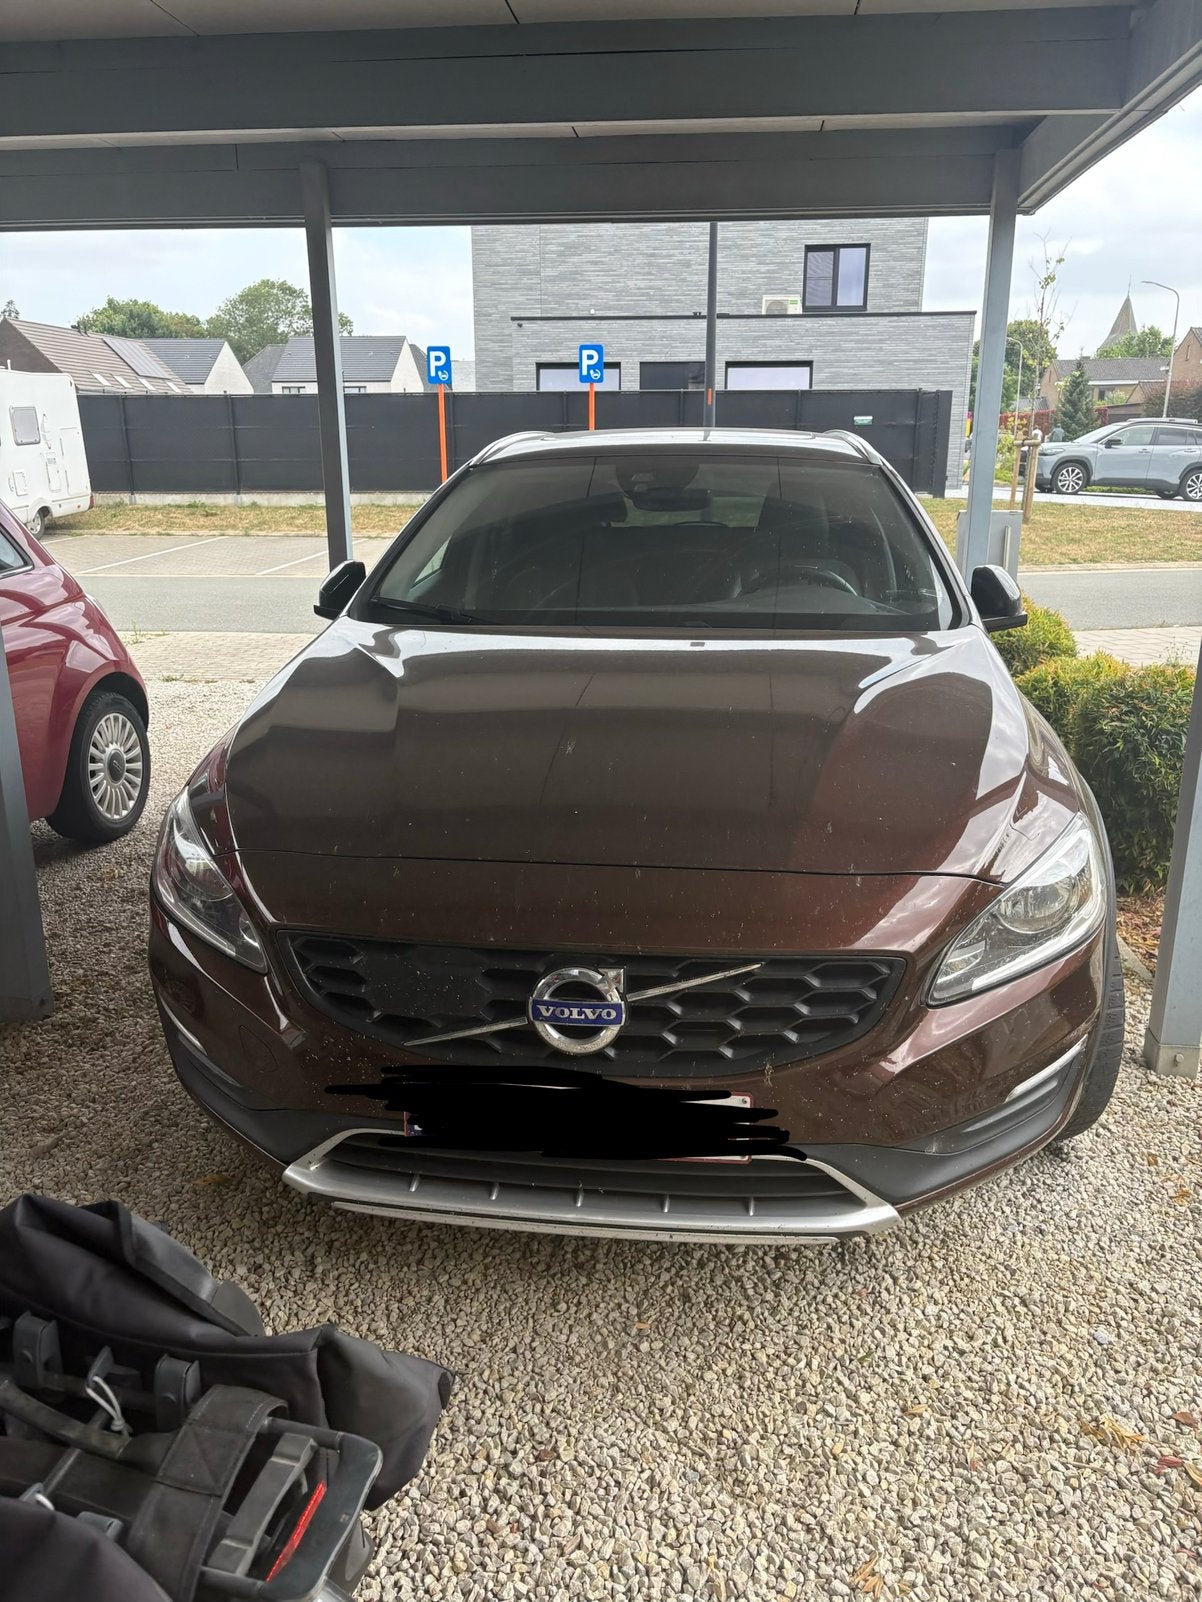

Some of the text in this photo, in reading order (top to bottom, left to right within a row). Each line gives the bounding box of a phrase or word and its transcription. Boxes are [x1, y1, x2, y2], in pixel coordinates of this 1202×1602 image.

[429, 351, 446, 377] P
[581, 350, 599, 376] P
[536, 1005, 617, 1020] VOLVO
